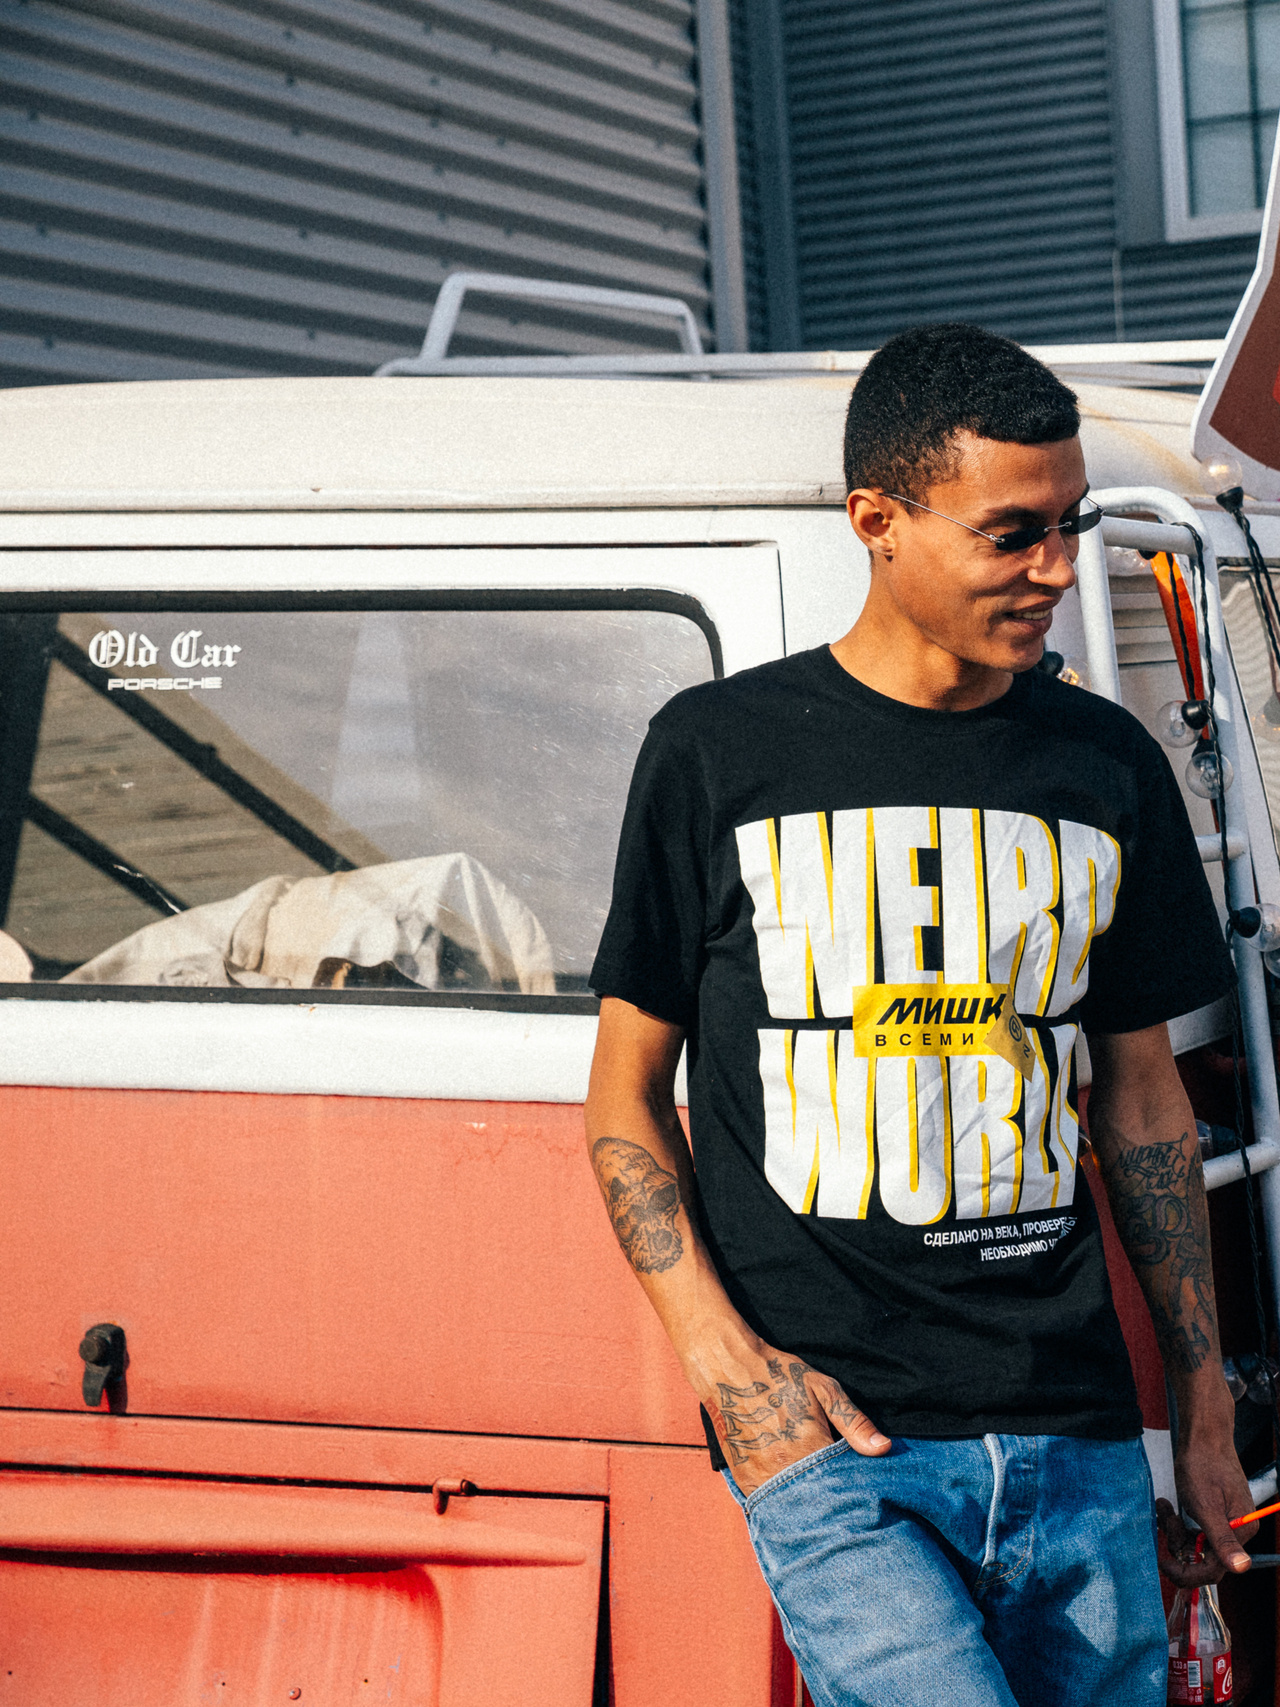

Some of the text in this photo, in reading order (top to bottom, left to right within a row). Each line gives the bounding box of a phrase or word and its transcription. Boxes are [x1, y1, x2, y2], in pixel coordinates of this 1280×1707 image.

[88, 629, 242, 669] Old Car
[107, 676, 223, 691] PORSCHE
[735, 806, 1121, 1019] WEIRD
[875, 1032, 990, 1047] ВСЕМИ
[923, 1229, 980, 1247] СДЕЛАНО
[980, 1228, 994, 1241] НА
[980, 1239, 1048, 1261] НЕОБХОДИМО
